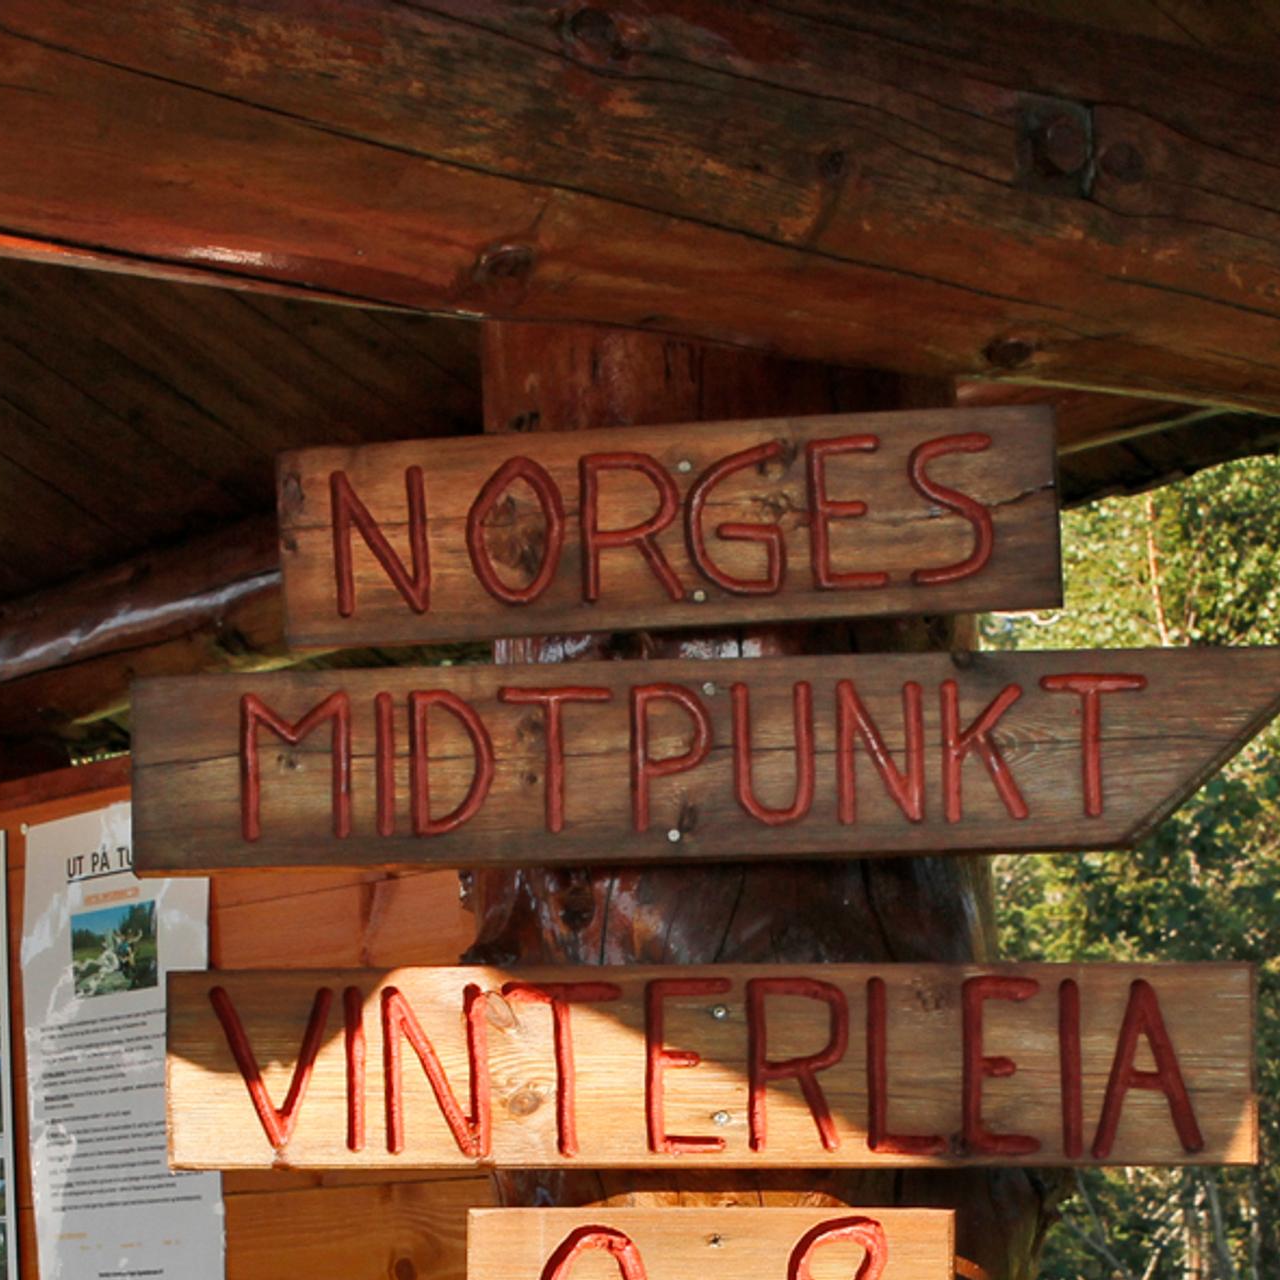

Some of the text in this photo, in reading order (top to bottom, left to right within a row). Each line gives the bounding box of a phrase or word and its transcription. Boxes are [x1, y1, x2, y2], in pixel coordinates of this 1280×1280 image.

[329, 431, 993, 617] NORGES
[239, 672, 1148, 841] MIDTPUNKT
[67, 855, 84, 878] UT
[91, 844, 111, 873] PÅ
[209, 976, 1204, 1159] VINTERLEIA
